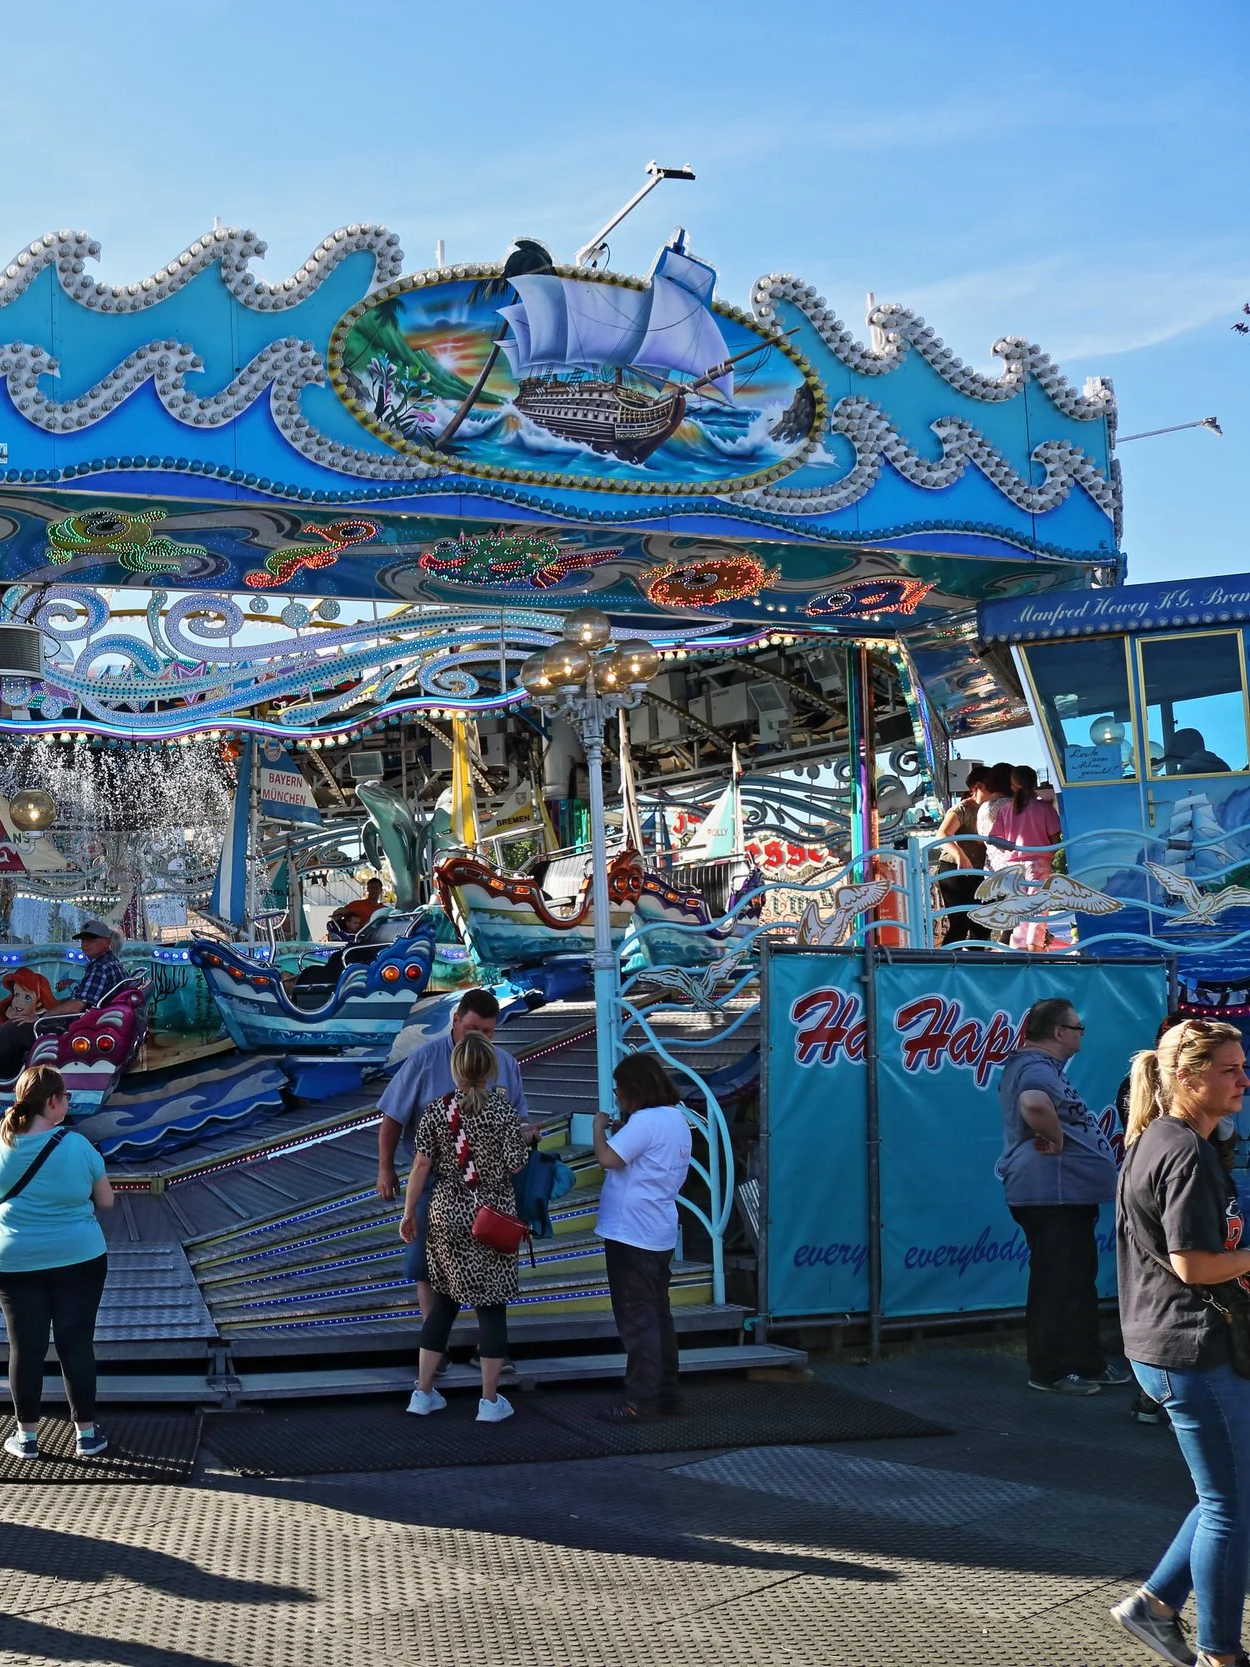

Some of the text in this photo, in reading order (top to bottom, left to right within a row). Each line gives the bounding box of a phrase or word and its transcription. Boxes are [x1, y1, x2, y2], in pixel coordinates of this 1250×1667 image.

[1014, 601, 1090, 625] Manfred
[269, 773, 303, 788] BAYERN
[262, 788, 307, 806] MÜNCHEN
[496, 815, 530, 827] BREMEN
[707, 828, 728, 837] POLLY
[791, 987, 868, 1066] Ha
[895, 995, 1031, 1088] Hap
[903, 1225, 1031, 1277] everybody
